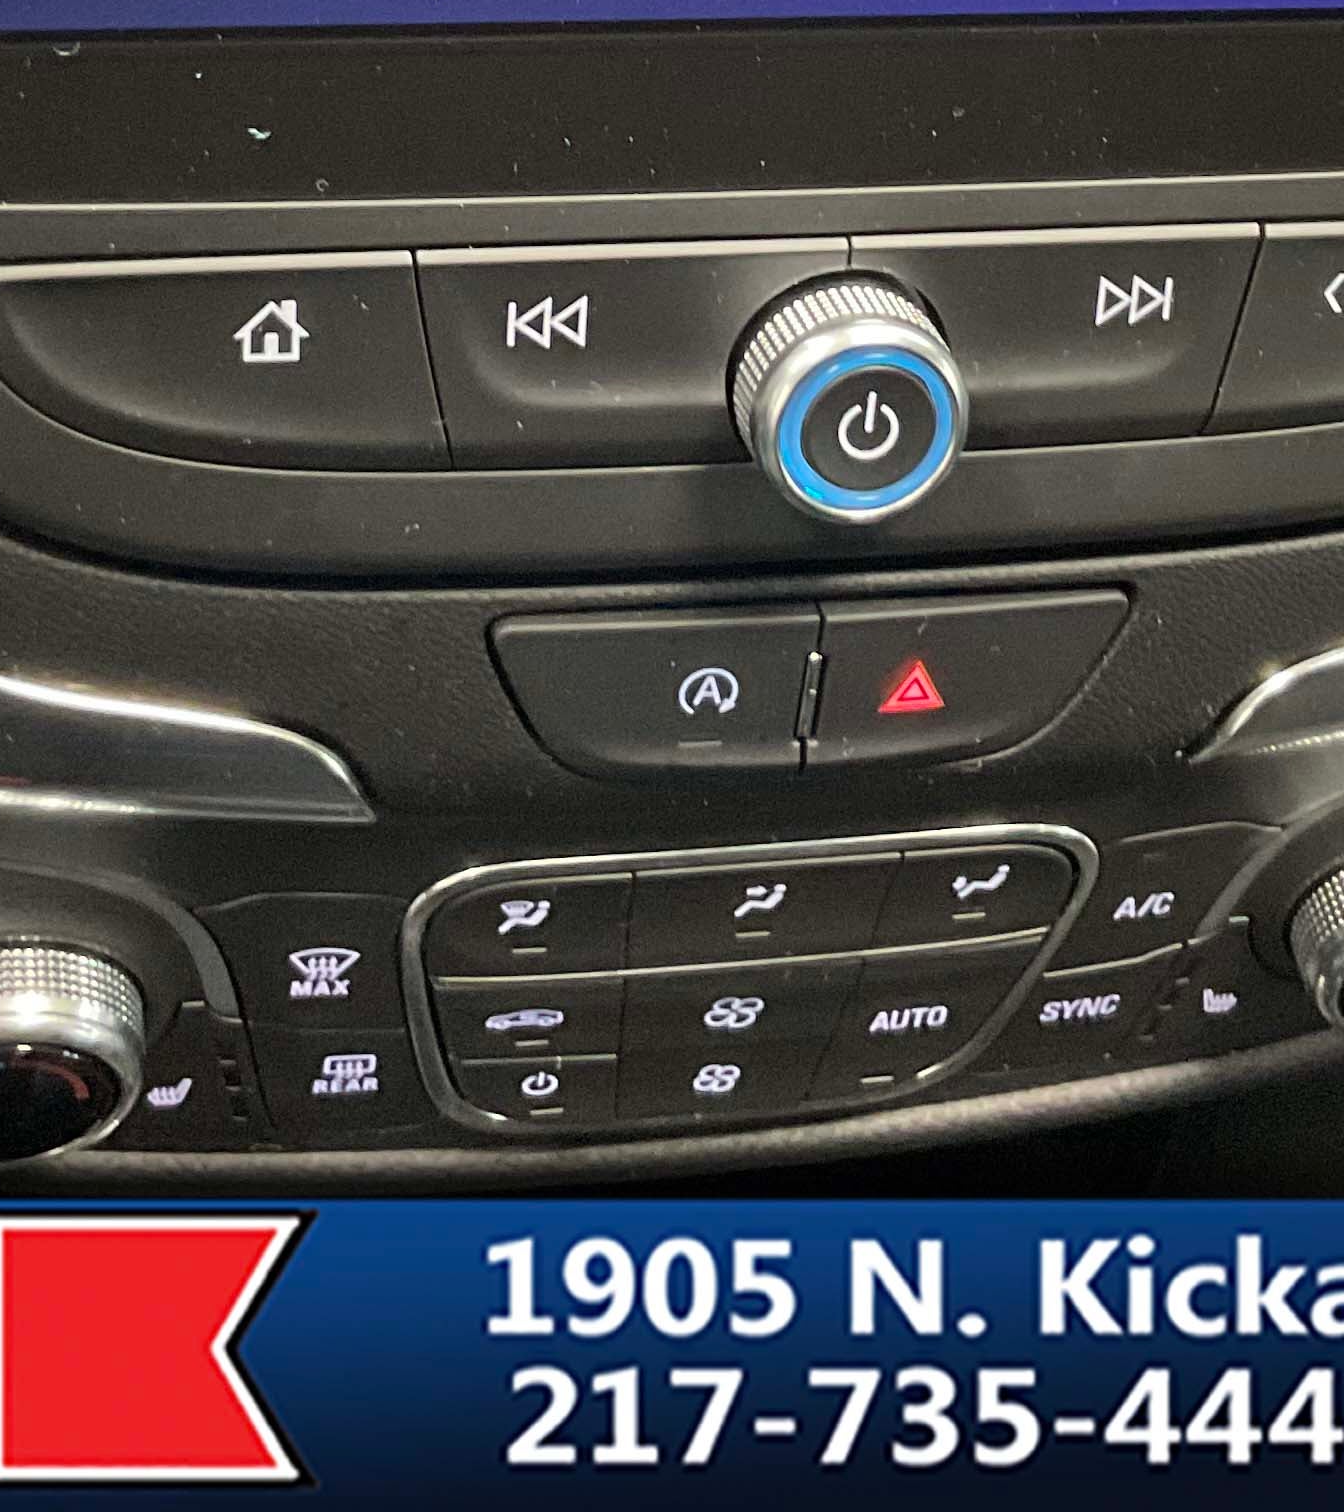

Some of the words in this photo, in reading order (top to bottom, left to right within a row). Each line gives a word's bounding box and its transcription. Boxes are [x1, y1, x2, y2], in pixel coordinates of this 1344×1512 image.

[1113, 891, 1175, 921] A/C
[289, 979, 350, 998] MAX
[869, 1005, 949, 1034] AUTO
[1039, 993, 1122, 1024] SYNC
[312, 1076, 378, 1094] REAR
